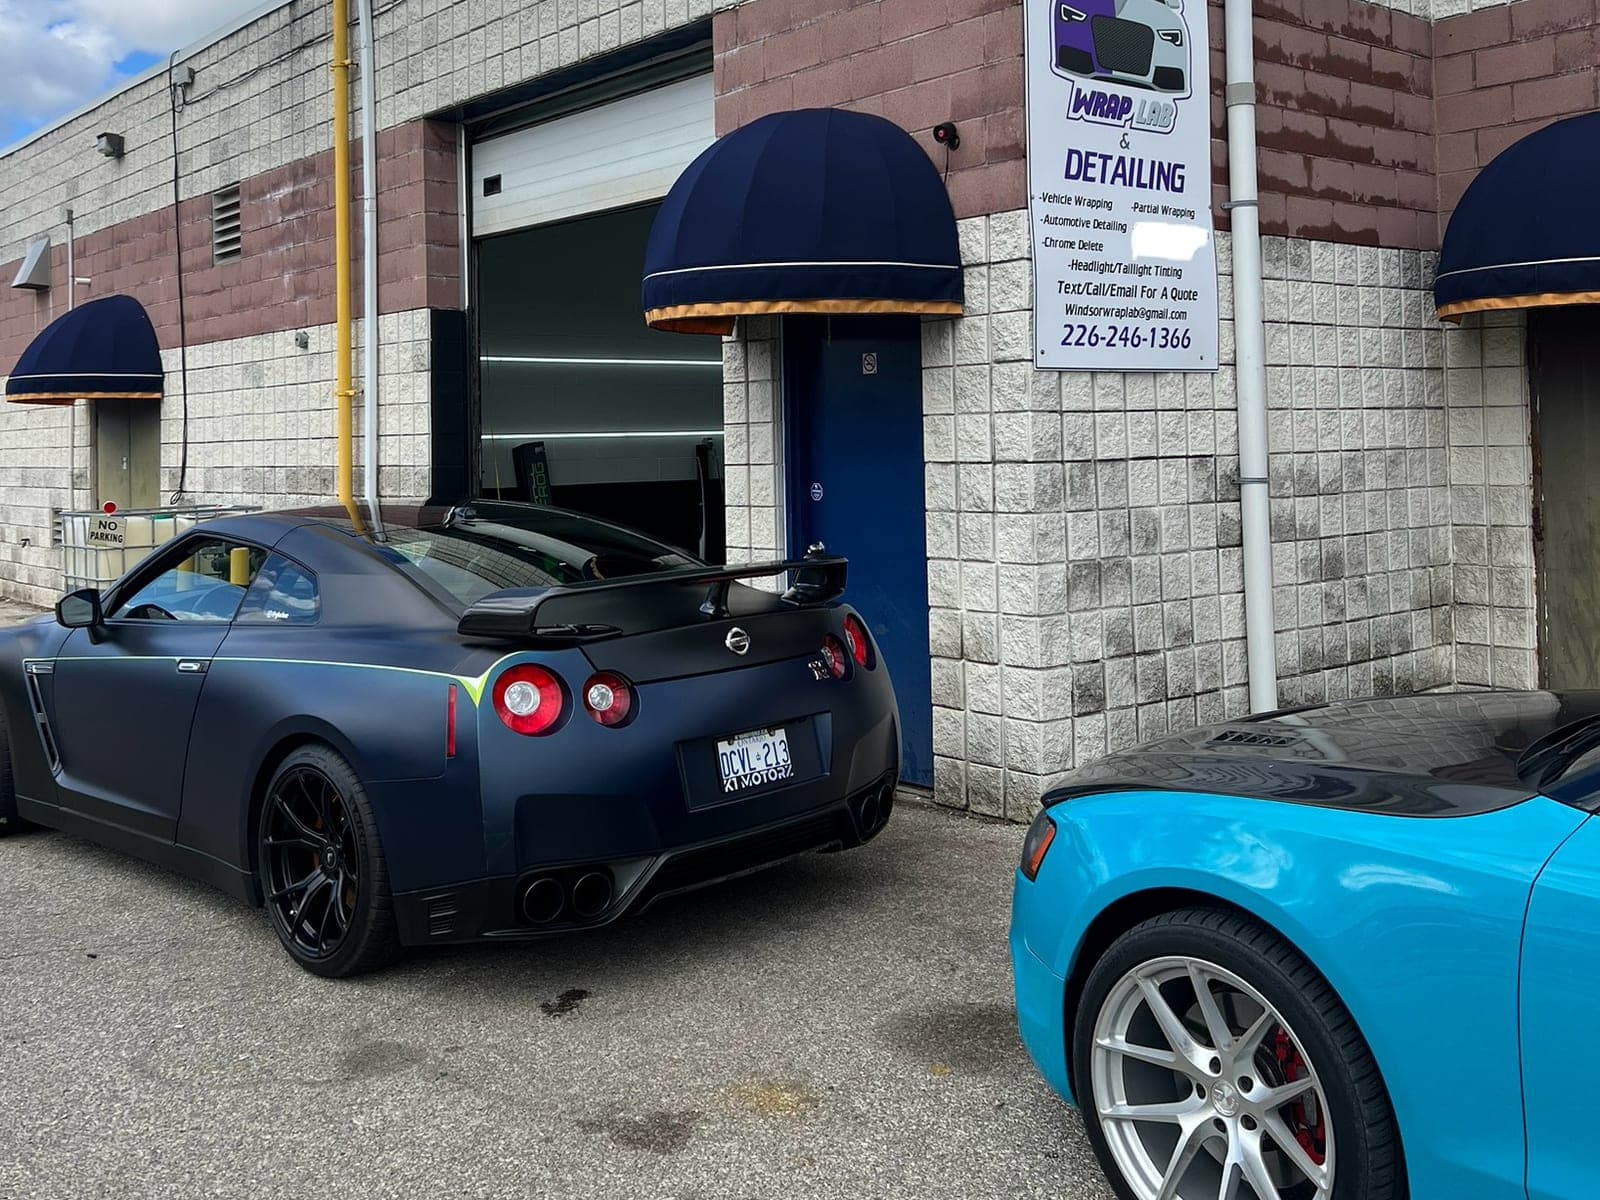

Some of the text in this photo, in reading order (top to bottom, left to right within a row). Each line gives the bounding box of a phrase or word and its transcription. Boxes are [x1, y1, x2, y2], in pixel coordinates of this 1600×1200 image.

[1072, 87, 1174, 128] WRAP LAB
[1119, 132, 1130, 150] &
[1064, 148, 1186, 194] DETAILING
[1039, 191, 1113, 211] -Vehicle Wrapping
[1131, 202, 1196, 220] -Partial Wrapping
[1092, 218, 1128, 234] Detailing
[1041, 236, 1104, 252] -Chrome Delete
[1154, 265, 1183, 280] Tinting
[1057, 280, 1199, 302] Text/Call/Email For A Quote
[1065, 303, 1187, 321] Windsorwraplab@gmail.com
[1060, 323, 1191, 349] 226-246-1366
[98, 519, 118, 531] NO
[89, 531, 123, 543] PARKING
[720, 739, 789, 778] DCVL 213
